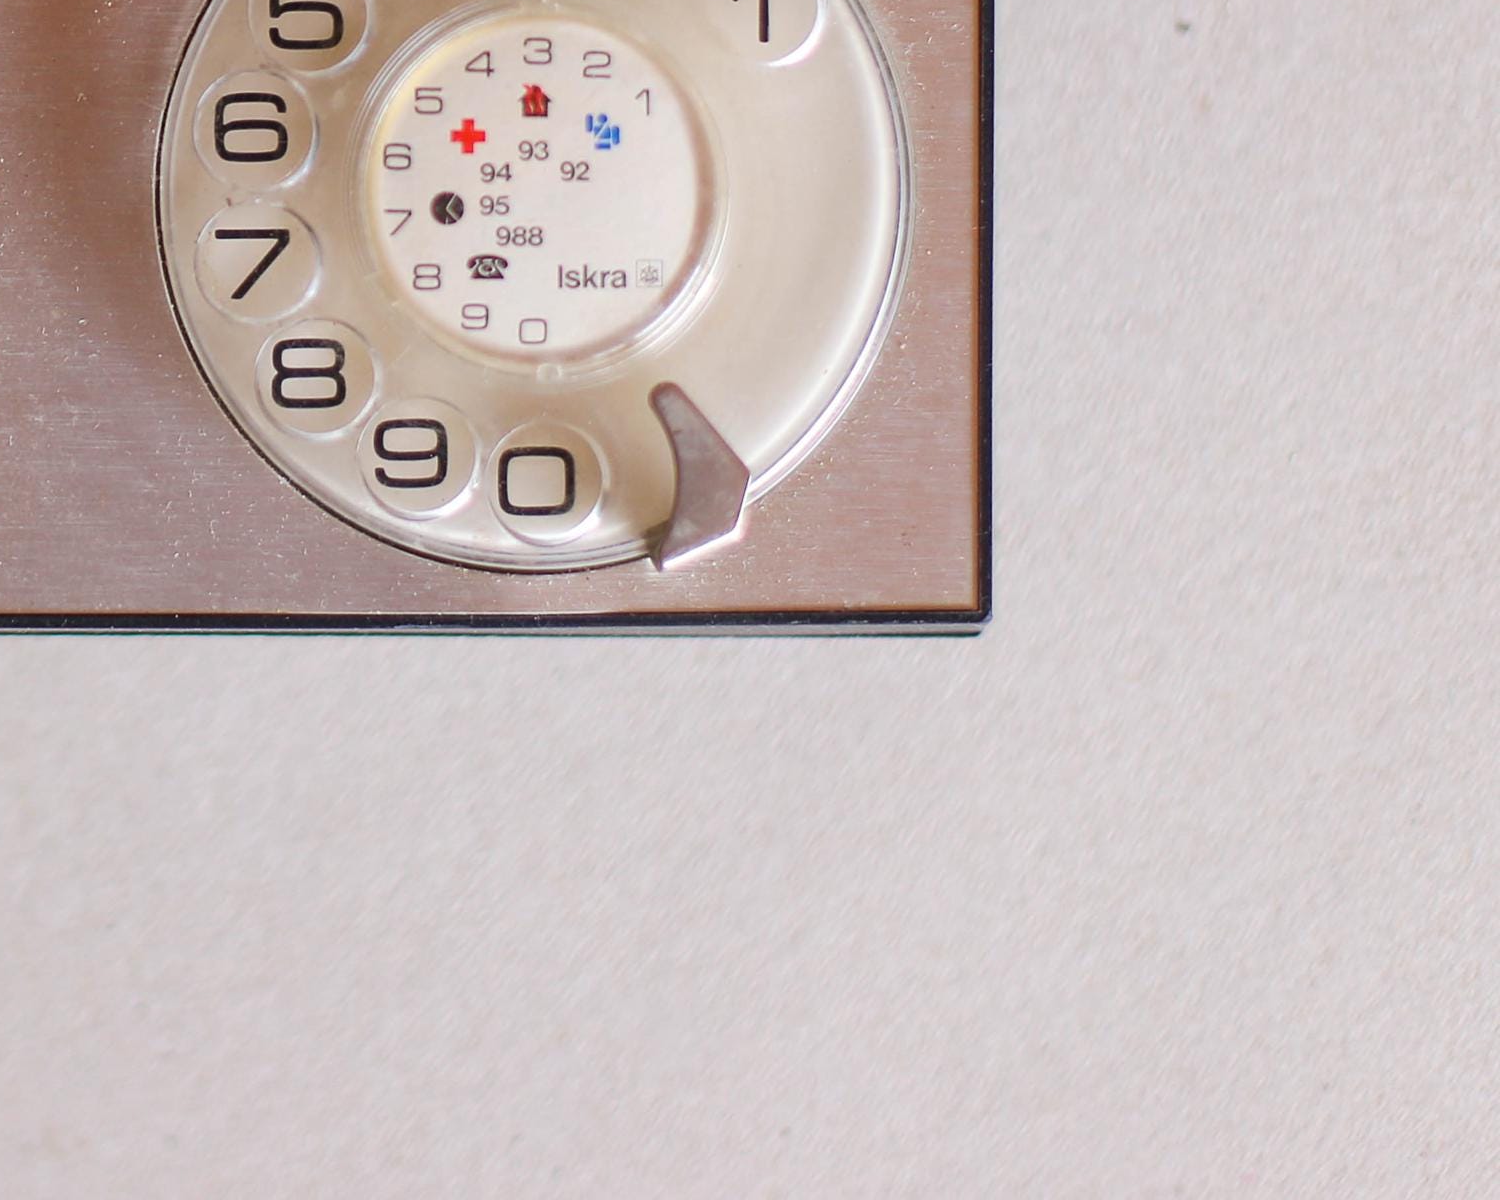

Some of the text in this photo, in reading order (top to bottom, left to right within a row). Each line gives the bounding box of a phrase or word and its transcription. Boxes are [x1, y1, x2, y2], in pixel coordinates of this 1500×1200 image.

[464, 51, 495, 78] 4
[523, 37, 552, 65] 3
[582, 51, 612, 79] 2
[414, 87, 444, 115] 5
[635, 88, 651, 116] 1
[214, 92, 288, 164] 6
[383, 142, 412, 171] 6
[518, 141, 550, 161] 93
[480, 163, 512, 183] 94
[560, 161, 590, 182] 92
[479, 195, 510, 216] 95
[383, 208, 413, 237] 7
[495, 226, 544, 247] 988
[213, 228, 291, 300] 7
[412, 263, 442, 291] 8
[558, 264, 628, 289] Iskra
[461, 303, 489, 330] 9
[518, 318, 548, 344] 0
[271, 338, 347, 409] 8
[374, 418, 449, 489] 9
[498, 445, 576, 517] 0
